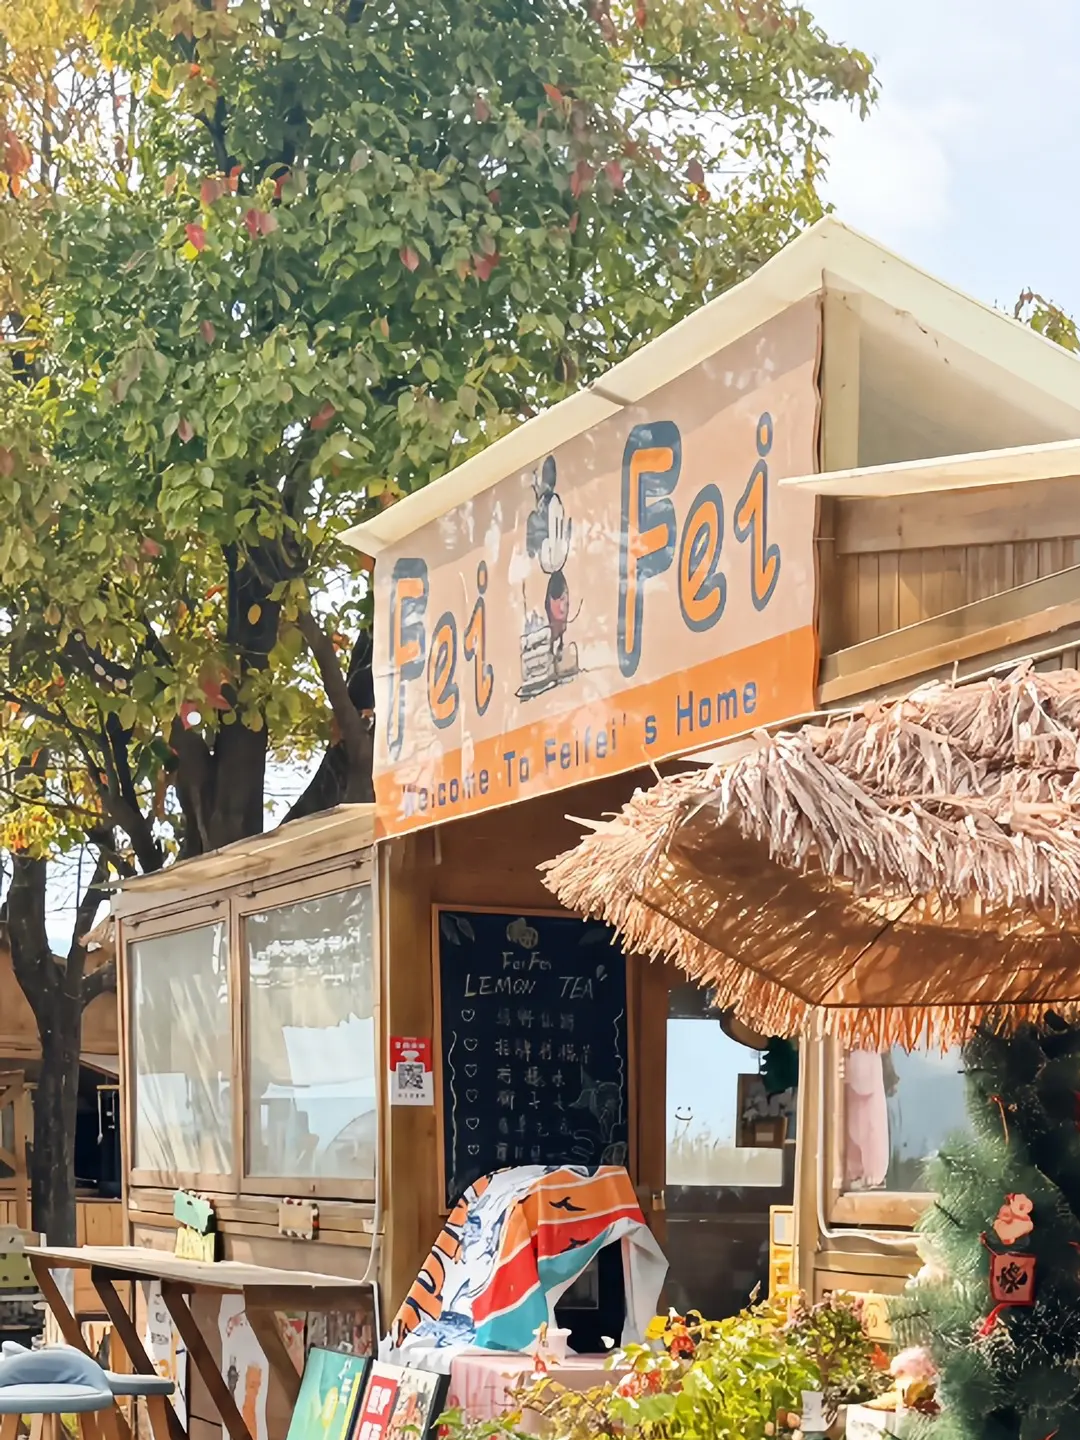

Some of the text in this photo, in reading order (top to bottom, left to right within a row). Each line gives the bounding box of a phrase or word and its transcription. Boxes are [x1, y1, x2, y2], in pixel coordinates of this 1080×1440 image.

[387, 411, 782, 762] Fei Fei
[503, 750, 530, 788] To
[676, 681, 758, 737] Home
[463, 973, 594, 1000] LEMON TEA
